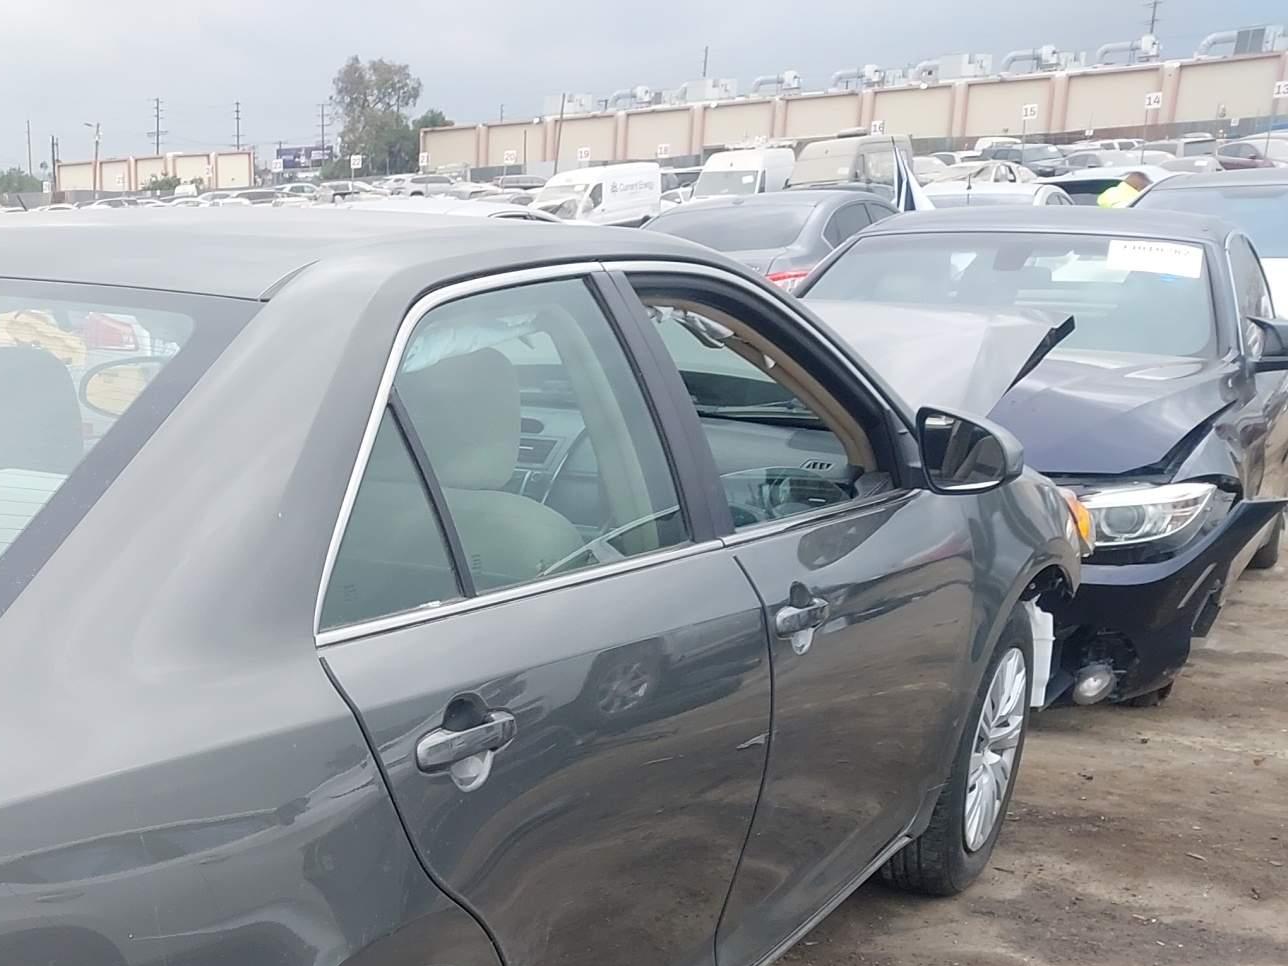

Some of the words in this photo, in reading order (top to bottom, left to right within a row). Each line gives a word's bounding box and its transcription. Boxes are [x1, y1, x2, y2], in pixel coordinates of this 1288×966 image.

[1146, 95, 1161, 106] 14
[1023, 105, 1036, 117] 15
[504, 152, 516, 161] 20
[579, 149, 590, 159] 19
